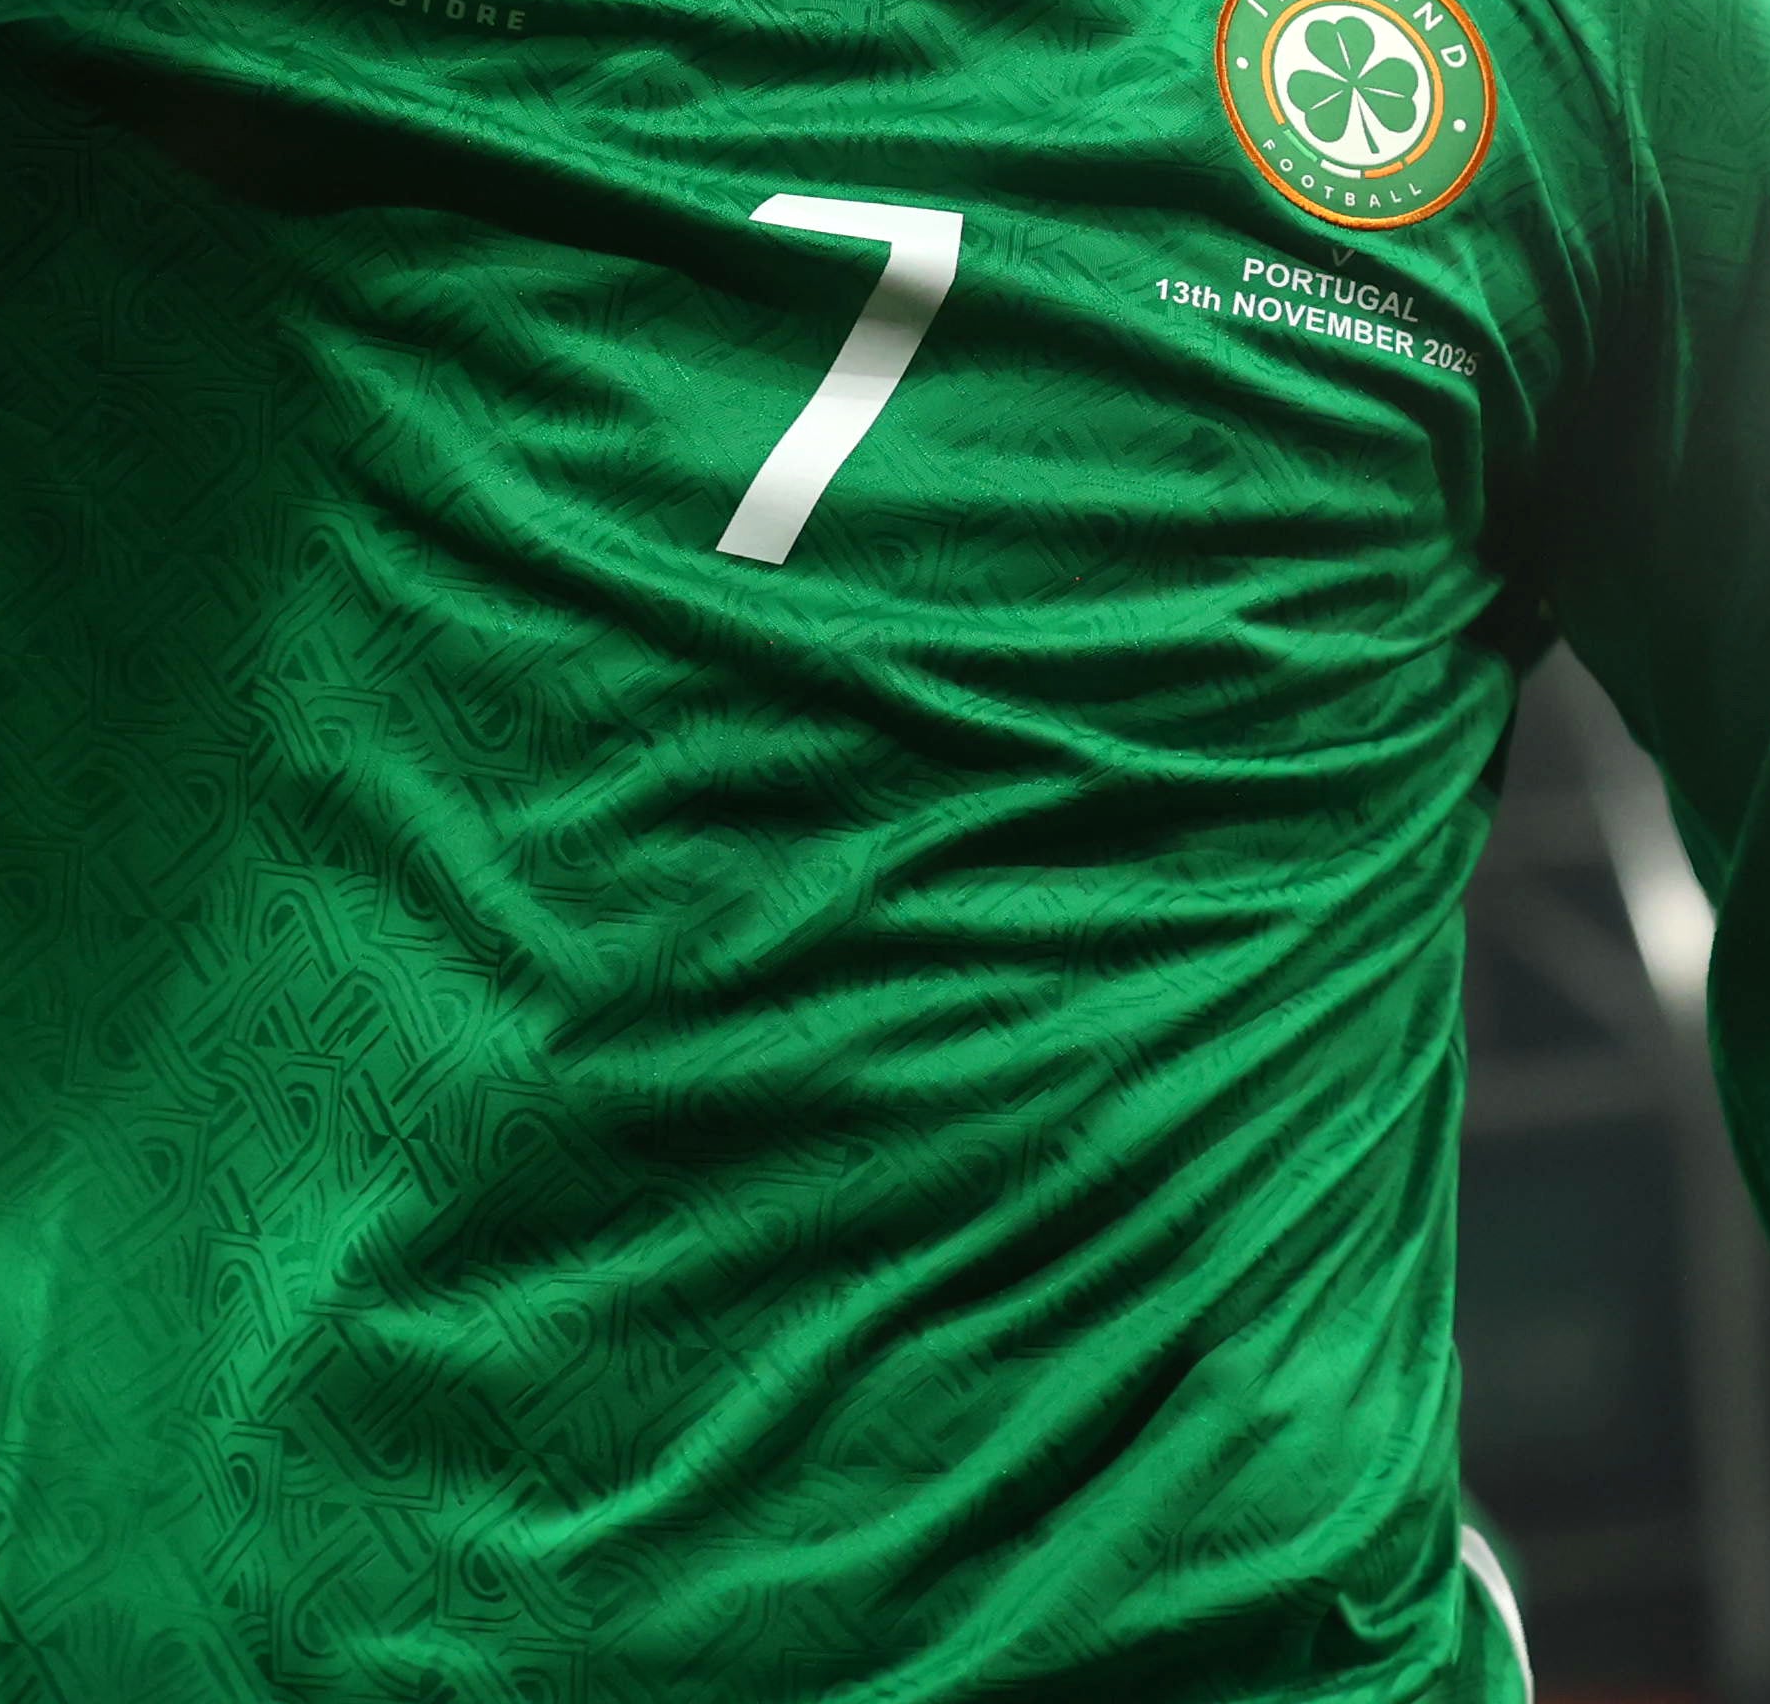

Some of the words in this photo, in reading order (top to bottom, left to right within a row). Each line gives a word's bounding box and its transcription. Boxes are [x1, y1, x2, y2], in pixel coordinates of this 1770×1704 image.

[1261, 138, 1423, 209] FOOTBALL
[1154, 278, 1222, 312] 13th
[1231, 291, 1415, 359] NOVEMBER
[1421, 338, 1479, 377] 2025
[1242, 256, 1419, 323] PORTUGAL
[715, 192, 965, 566] 7
